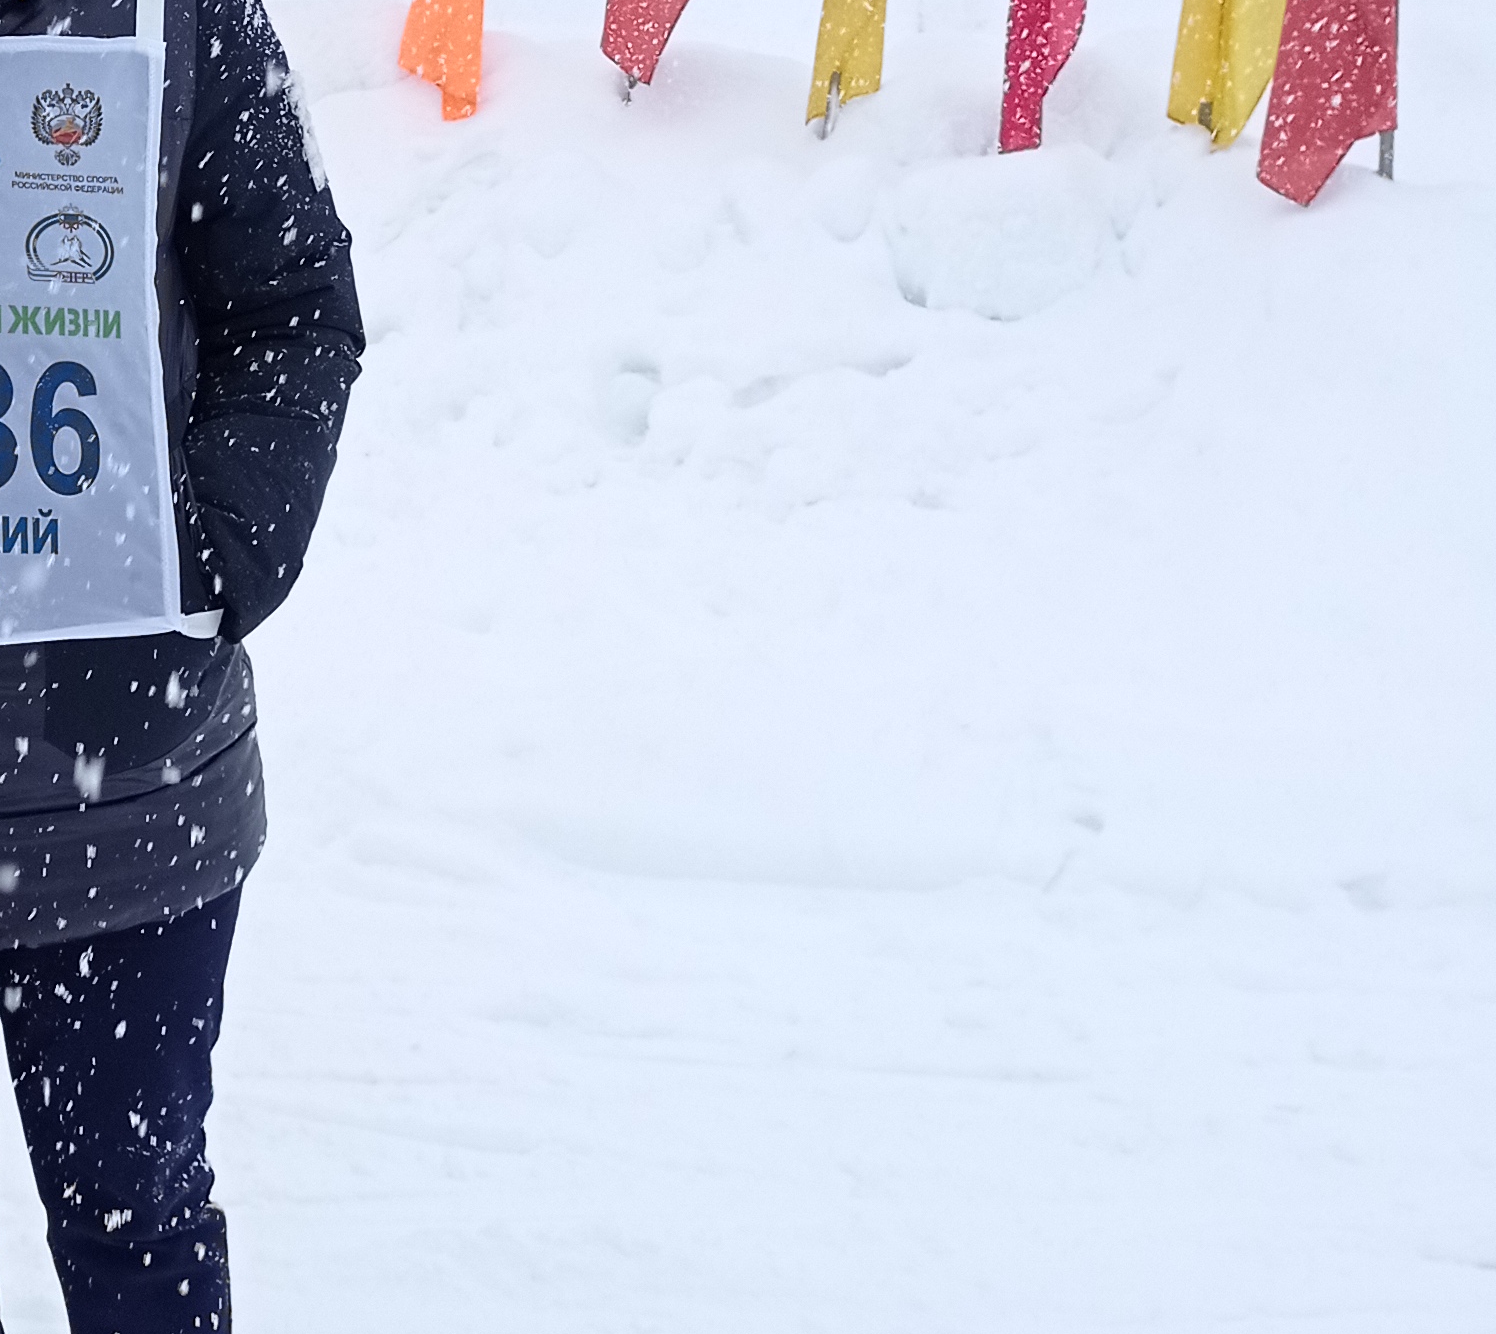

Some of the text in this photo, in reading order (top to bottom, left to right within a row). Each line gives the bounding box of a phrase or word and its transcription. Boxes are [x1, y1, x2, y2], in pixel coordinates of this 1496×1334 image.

[14, 170, 119, 185] МИНИСТЕРСТВО СПОРТА
[11, 180, 125, 195] РОССИЙСКОЙ ФЕДЕРАЦИИ
[6, 304, 123, 340] ЖИЗНИ
